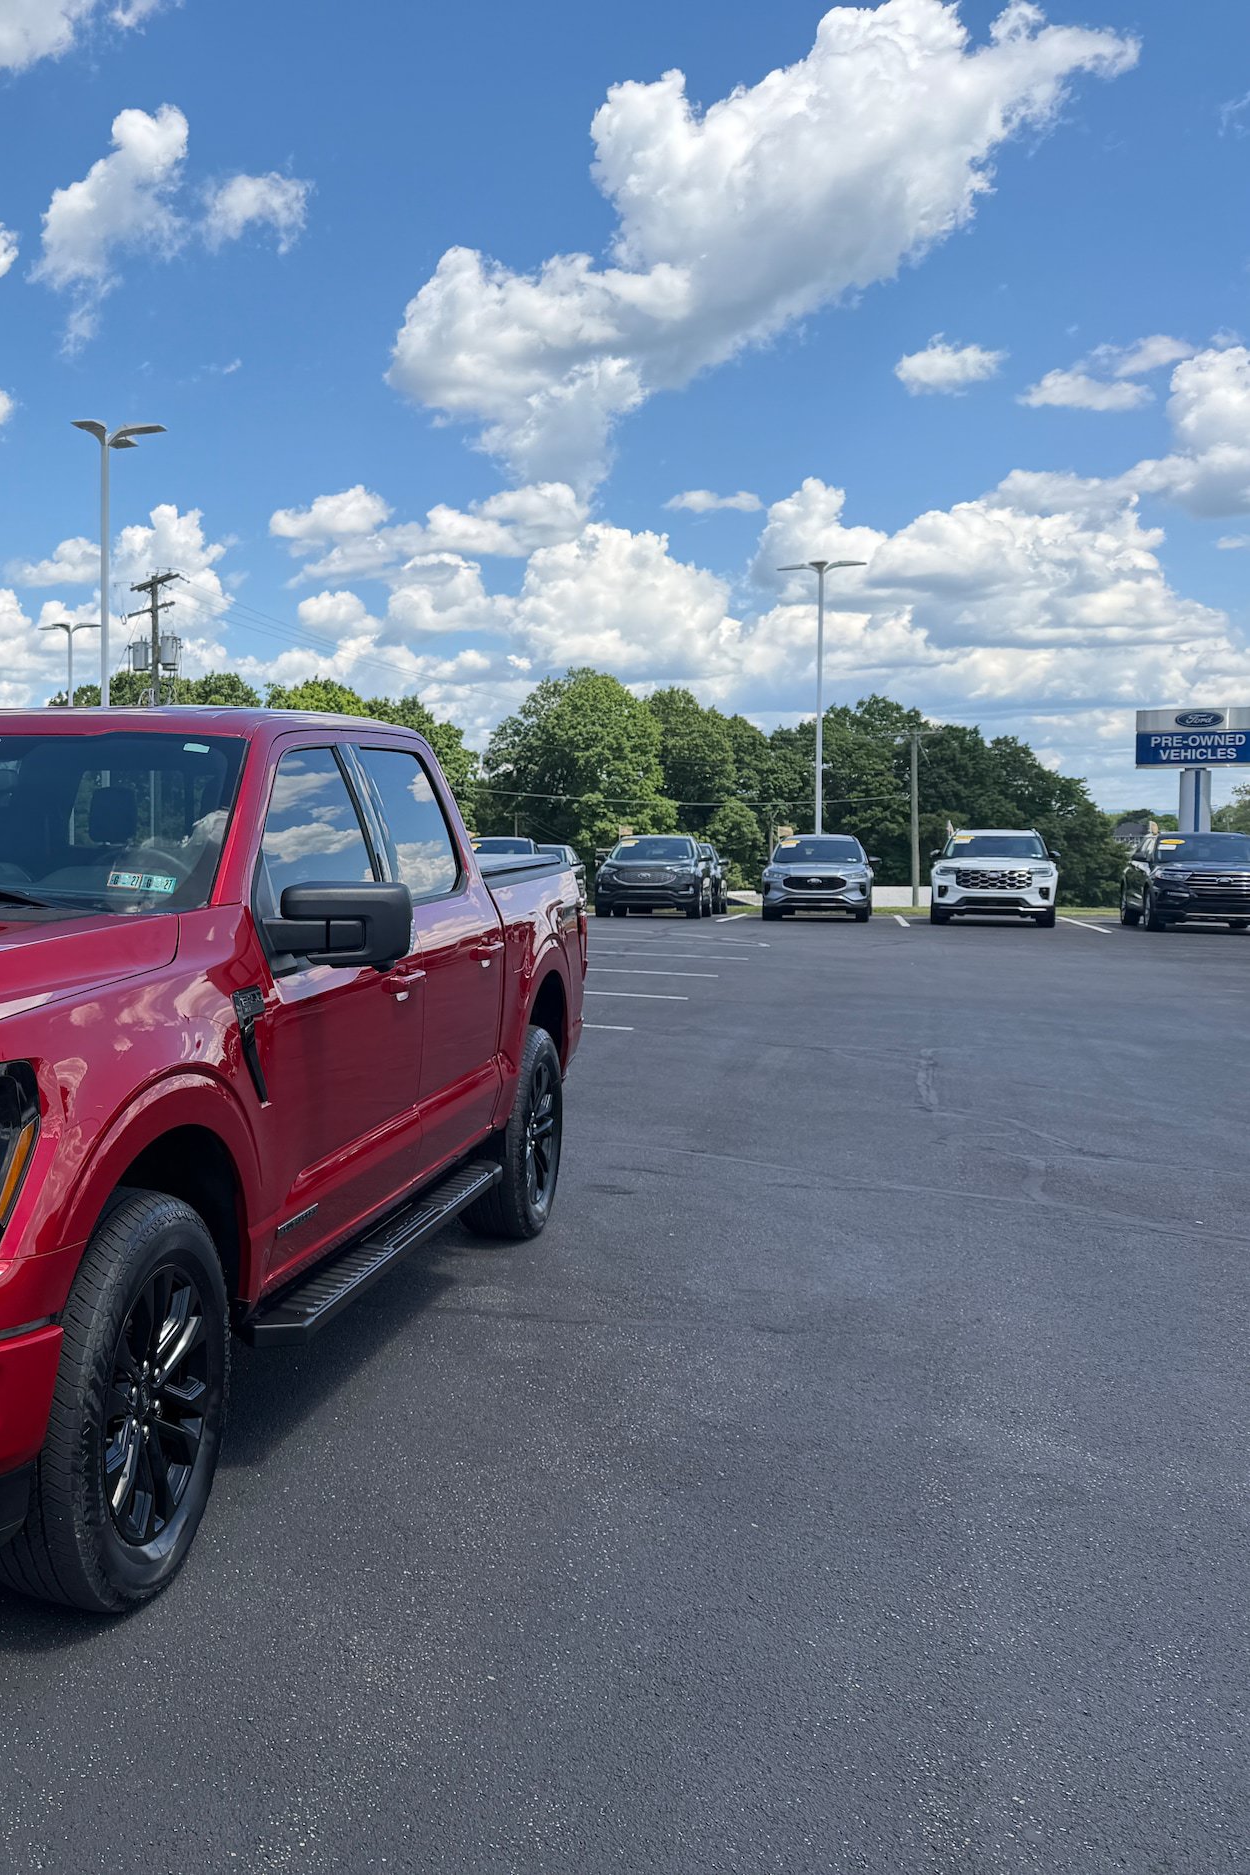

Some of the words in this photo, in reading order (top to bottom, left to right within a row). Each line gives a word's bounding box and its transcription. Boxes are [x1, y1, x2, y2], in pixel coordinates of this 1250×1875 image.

[1186, 714, 1214, 724] Ford
[1151, 734, 1246, 748] PRE-OWNED
[1159, 748, 1237, 761] VEHICLES
